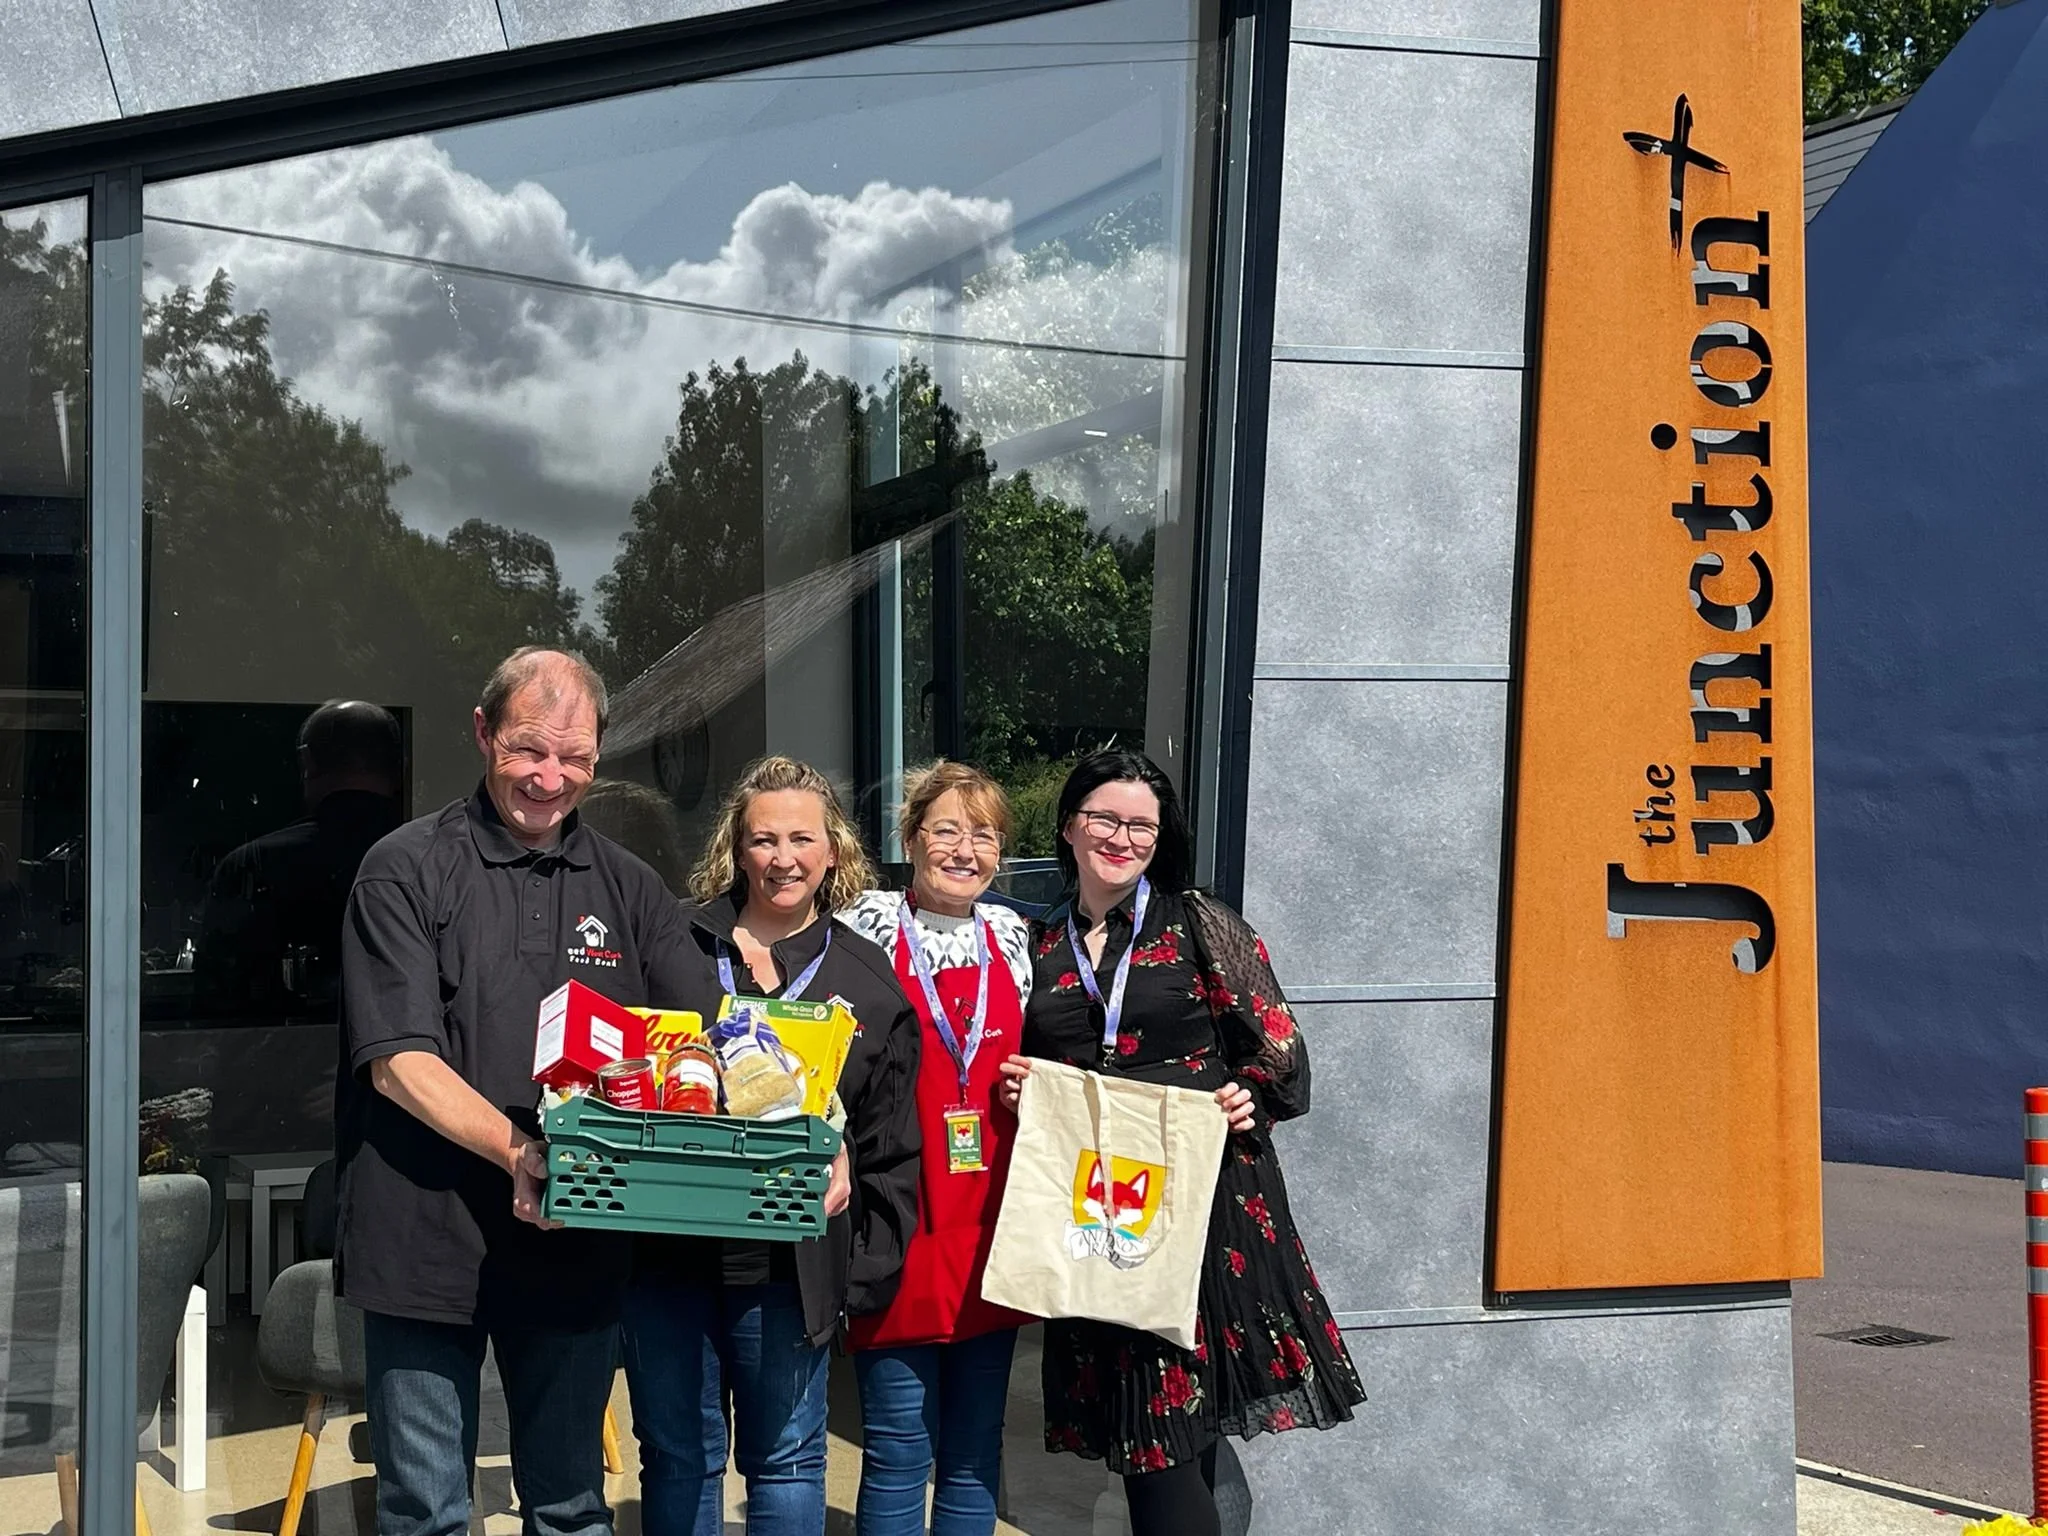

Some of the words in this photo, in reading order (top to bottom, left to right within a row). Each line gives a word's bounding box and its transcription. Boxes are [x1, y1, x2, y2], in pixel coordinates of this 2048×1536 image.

[1607, 211, 1776, 973] Junction
[1633, 764, 1676, 847] the
[607, 1085, 641, 1099] Chopped
